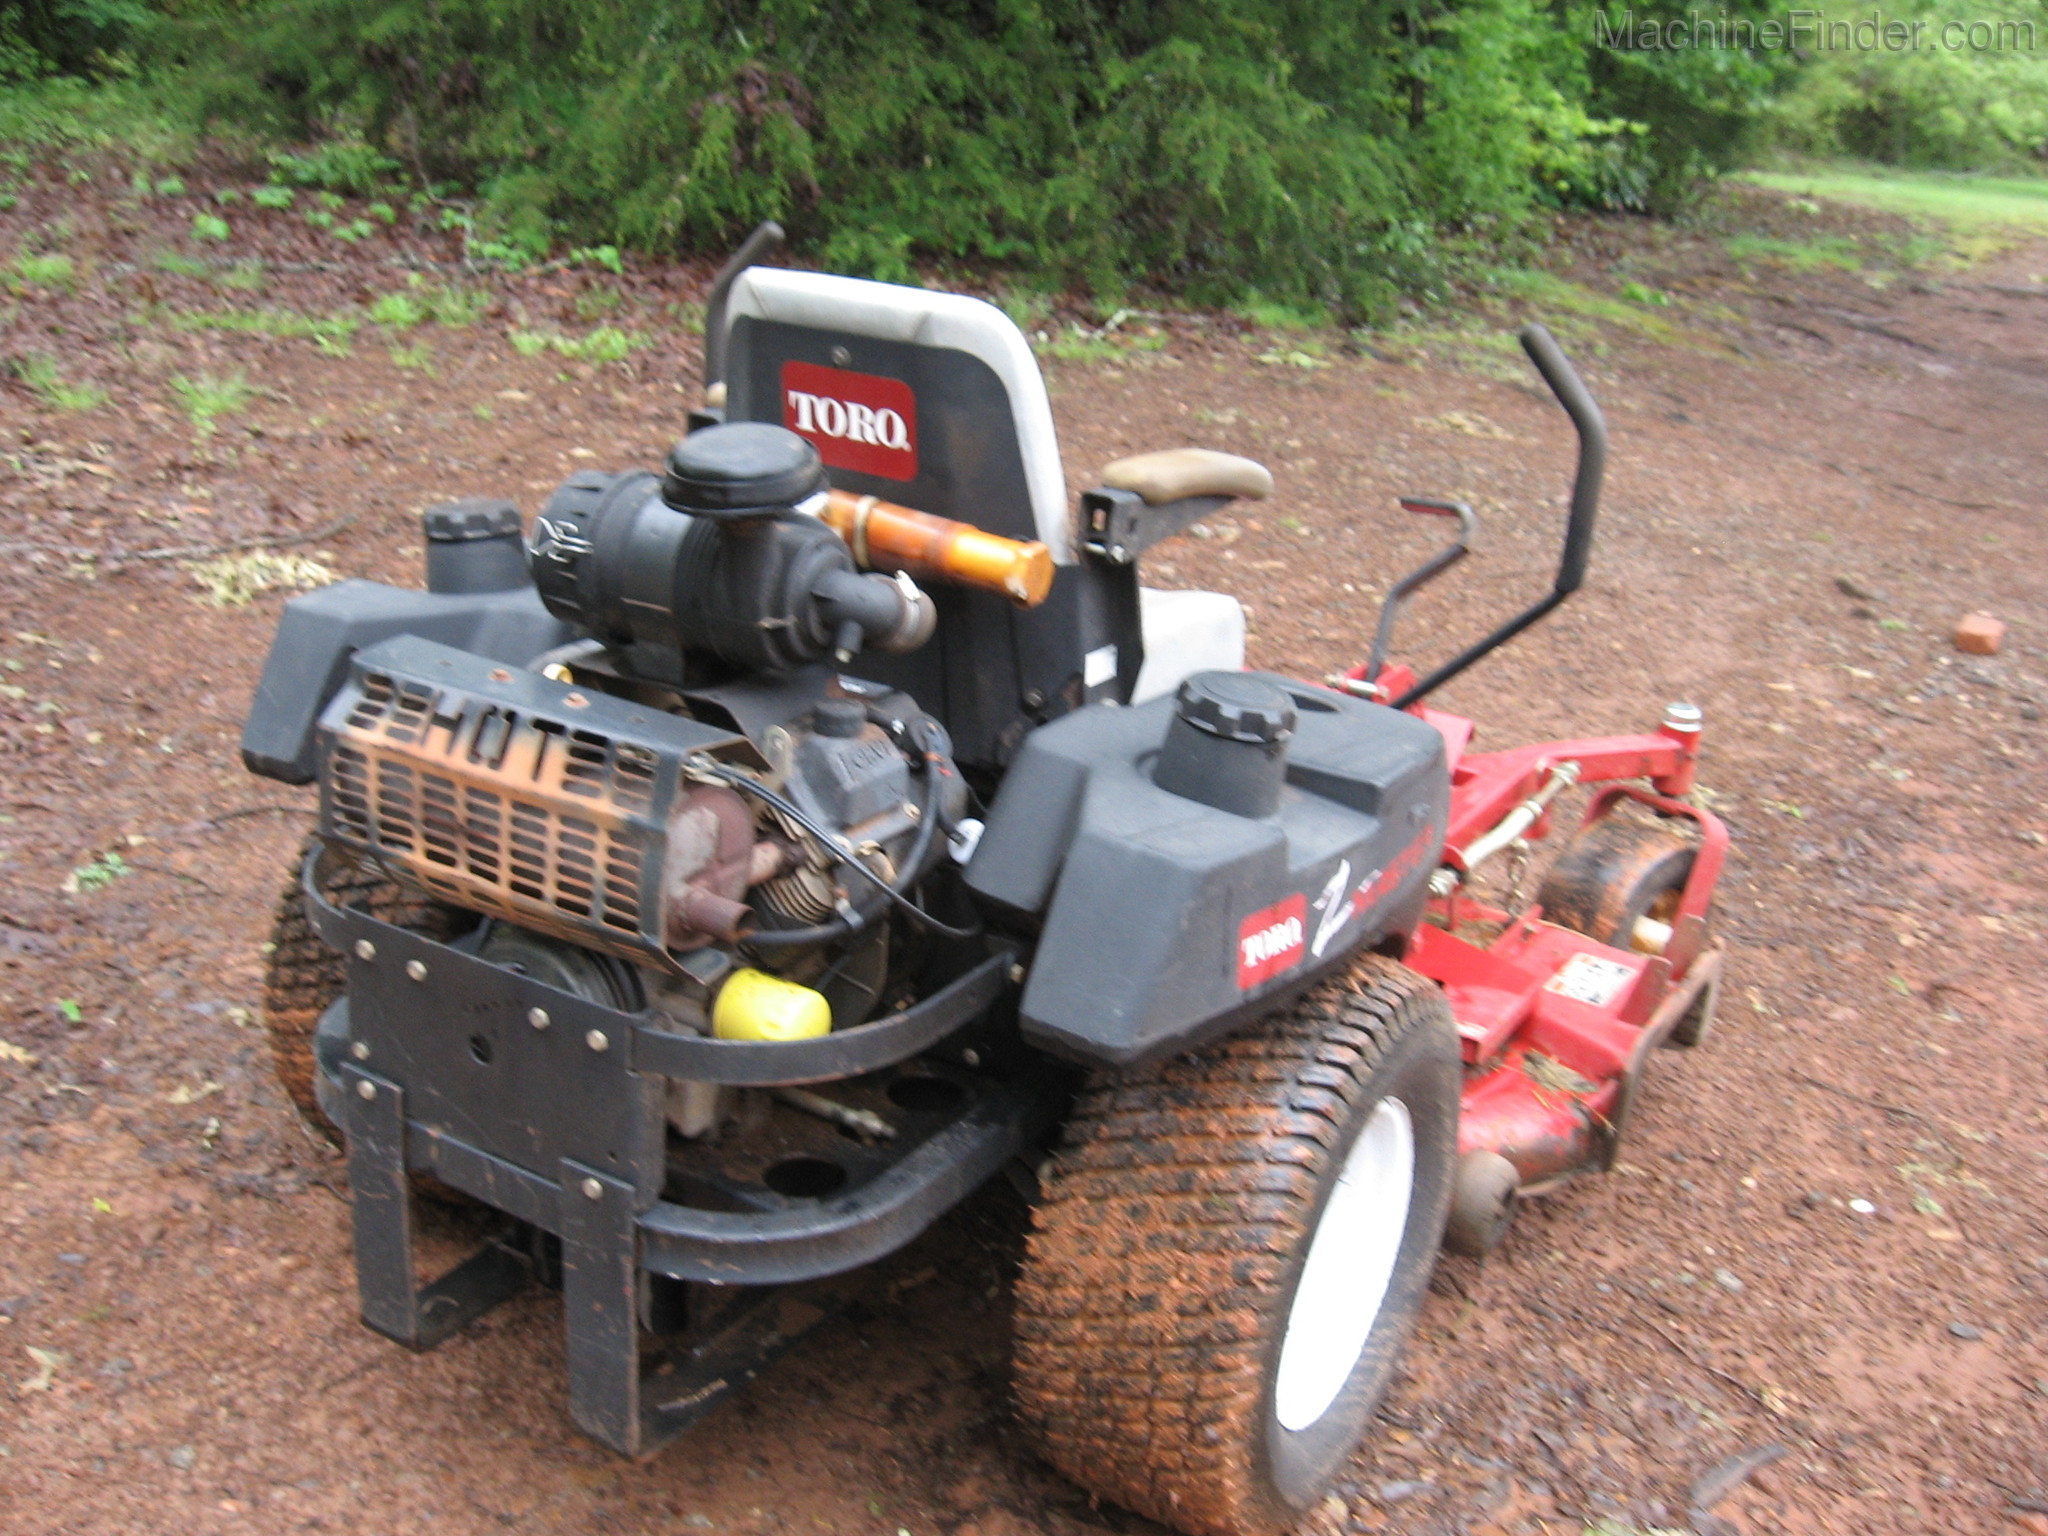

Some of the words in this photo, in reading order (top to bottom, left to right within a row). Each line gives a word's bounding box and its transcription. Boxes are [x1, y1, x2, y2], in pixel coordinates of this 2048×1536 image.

[787, 389, 912, 452] TORO
[420, 690, 564, 781] HOT
[1241, 916, 1303, 967] TORO
